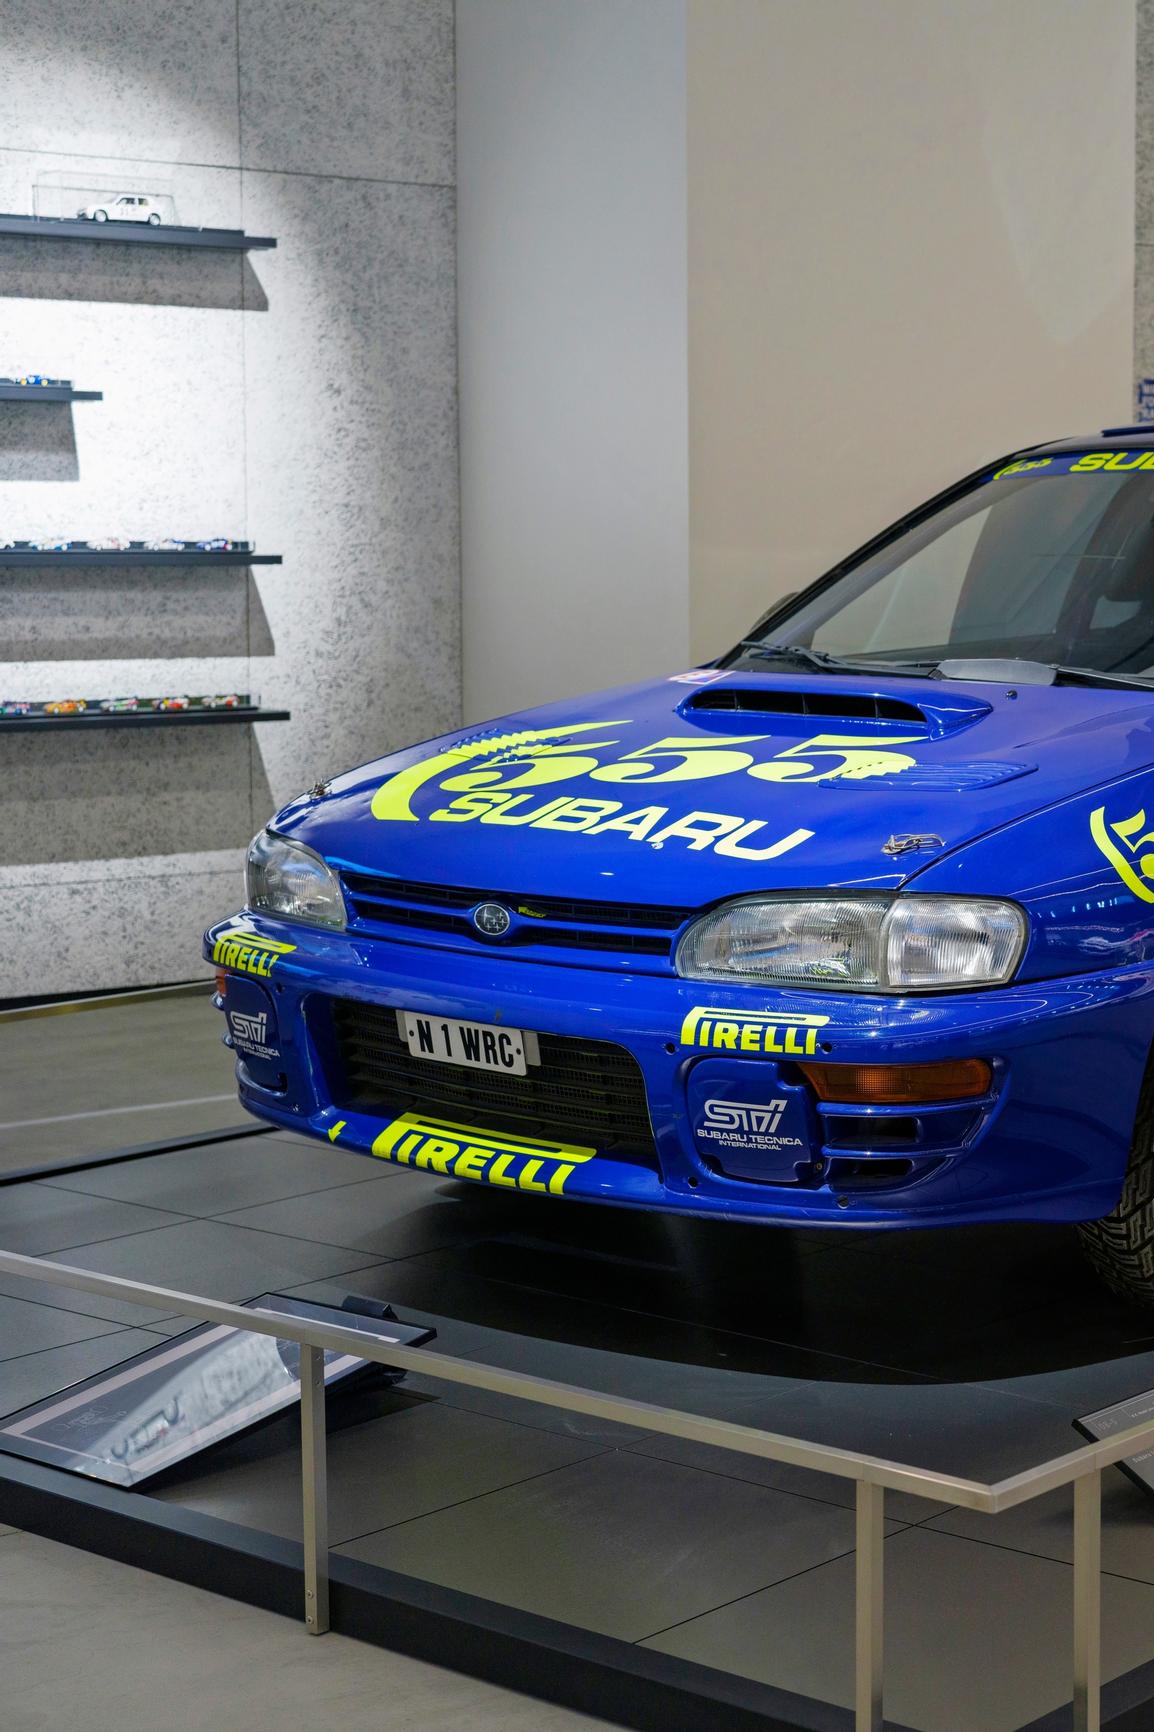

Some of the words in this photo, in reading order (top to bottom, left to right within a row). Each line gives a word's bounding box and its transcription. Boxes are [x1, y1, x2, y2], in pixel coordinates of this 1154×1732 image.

[429, 792, 816, 861] SUBARU
[212, 931, 297, 978] PIRELLI
[416, 1019, 435, 1054] N
[441, 1024, 453, 1057] 1
[459, 1026, 514, 1068] WRC
[680, 1006, 831, 1055] PIRELLI
[371, 1112, 598, 1195] PIRELLI
[697, 1128, 747, 1142] SUBARU
[749, 1134, 803, 1146] TECNICA
[719, 1139, 782, 1151] INTERNATIONAL
